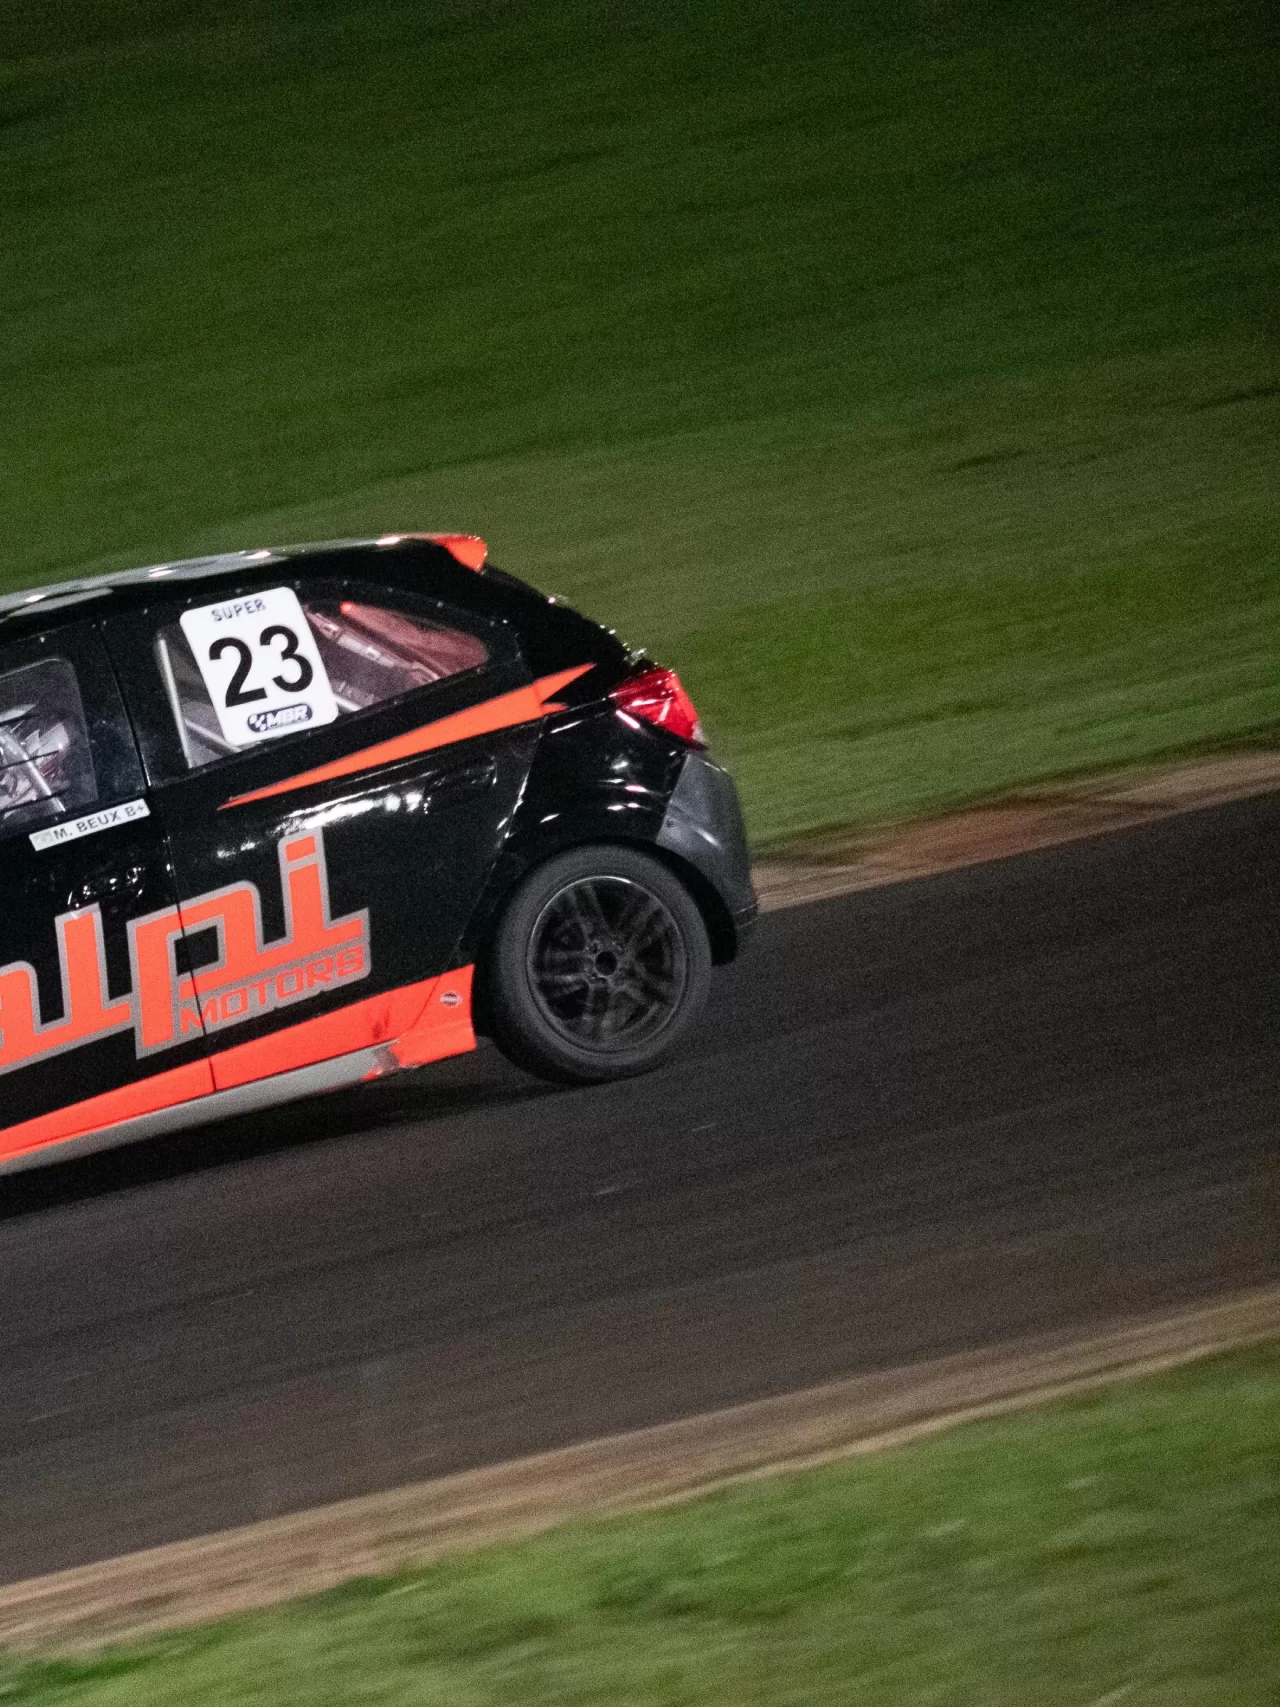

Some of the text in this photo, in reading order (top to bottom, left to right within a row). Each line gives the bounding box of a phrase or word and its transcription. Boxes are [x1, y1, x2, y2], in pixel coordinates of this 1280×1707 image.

[211, 599, 267, 622] SUPER
[209, 625, 314, 708] 23
[265, 704, 309, 729] MBR
[53, 828, 73, 840] M.
[76, 810, 122, 833] BEUX
[179, 945, 365, 1034] MOTORS
